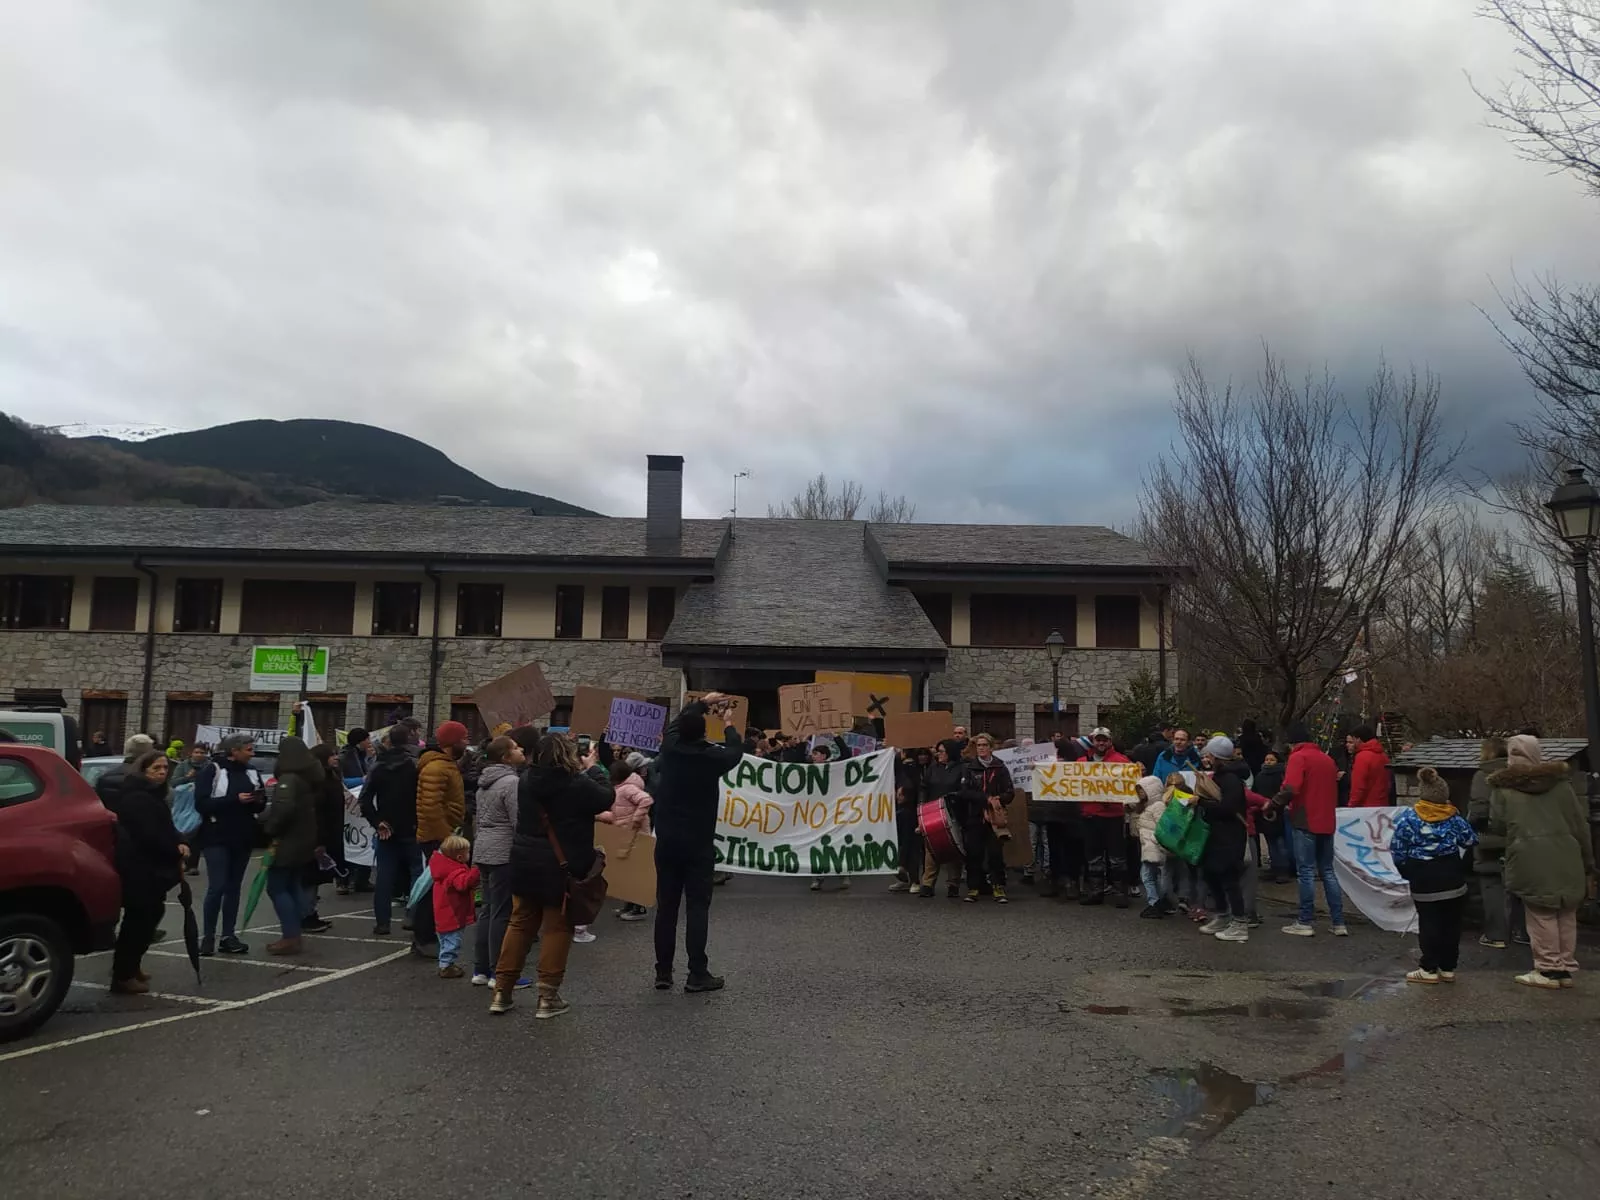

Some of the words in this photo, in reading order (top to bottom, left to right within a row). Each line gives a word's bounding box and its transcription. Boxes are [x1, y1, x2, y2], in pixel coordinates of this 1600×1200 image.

[266, 653, 298, 662] VALLE
[612, 700, 623, 714] LA
[624, 703, 661, 720] UNIDAD
[788, 711, 852, 732] VALLE
[606, 731, 618, 743] NO
[619, 731, 630, 743] SE
[845, 754, 879, 787] DE
[1060, 778, 1138, 797] SEPARACIO
[793, 799, 827, 829] NO
[834, 795, 863, 825] ES
[867, 793, 893, 823] UN
